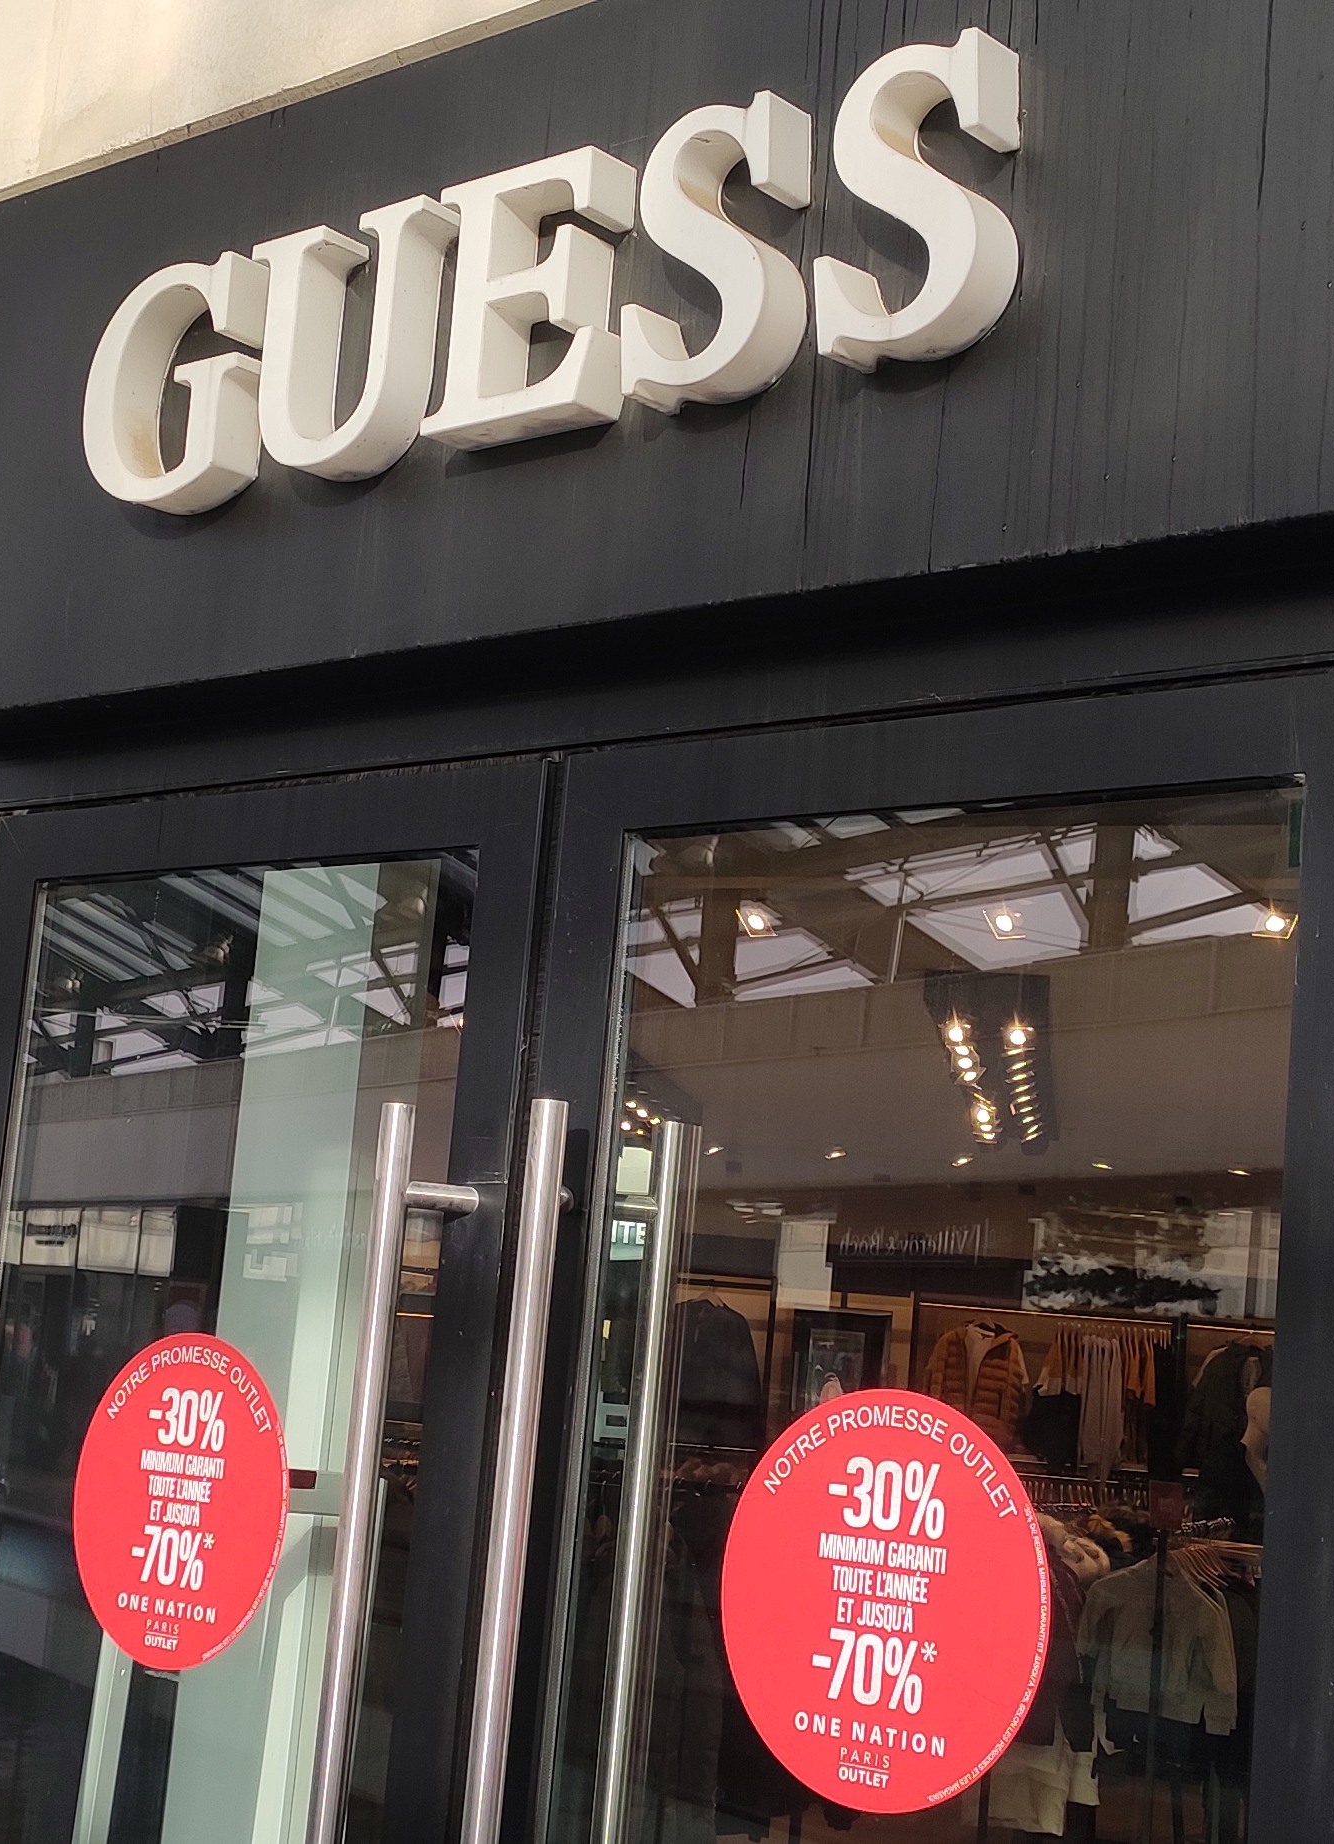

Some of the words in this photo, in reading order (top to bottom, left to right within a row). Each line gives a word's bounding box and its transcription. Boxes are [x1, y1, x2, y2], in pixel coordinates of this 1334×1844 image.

[81, 26, 1021, 516] GUESS
[107, 1361, 151, 1420] NOTRE
[151, 1346, 229, 1376] PROMESSE
[230, 1366, 272, 1434] OUTLET
[149, 1387, 225, 1452] -30%
[140, 1449, 184, 1475] MINIMUM
[185, 1455, 225, 1479] GARANTI
[763, 1423, 827, 1495] NOTRE
[827, 1406, 946, 1444] PROMESSE
[950, 1432, 1018, 1520] OUTLET
[148, 1475, 176, 1499] TOUTE
[177, 1478, 212, 1503] L'ANNÉE
[828, 1456, 946, 1540] -30%
[150, 1501, 163, 1521] ET
[163, 1502, 200, 1527] JUSQU'À
[819, 1532, 885, 1566] MINIMUM
[887, 1540, 946, 1574] GARANTI
[832, 1565, 874, 1597] TOUTE
[875, 1570, 929, 1604] L'ANNÉE
[118, 1592, 148, 1612] ONE
[154, 1595, 216, 1624] NATION
[837, 1597, 854, 1623] ET
[856, 1603, 913, 1634] JUSQU'À
[144, 1635, 178, 1651] OUTLET
[146, 1619, 180, 1635] PARIS
[794, 1711, 841, 1739] ONE
[851, 1717, 946, 1758] NATION
[839, 1747, 891, 1769] PARIS
[838, 1766, 889, 1789] OUTLET
